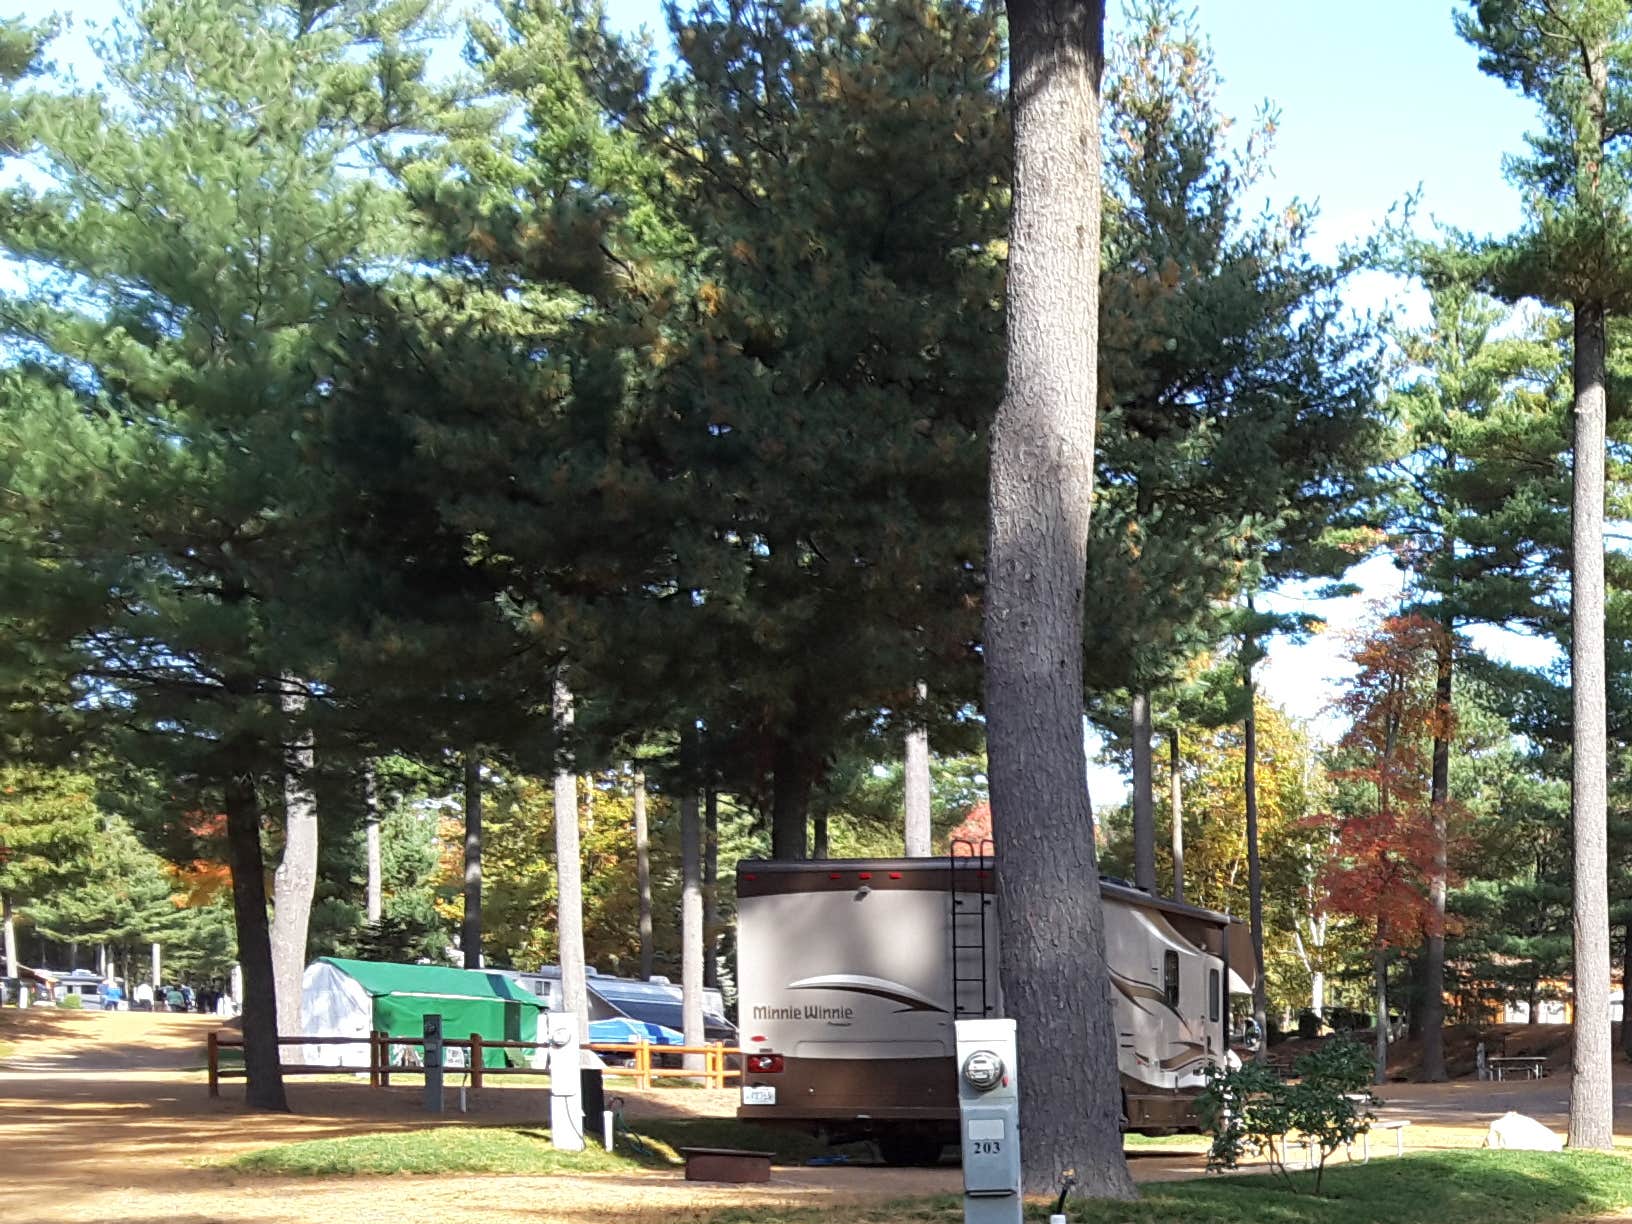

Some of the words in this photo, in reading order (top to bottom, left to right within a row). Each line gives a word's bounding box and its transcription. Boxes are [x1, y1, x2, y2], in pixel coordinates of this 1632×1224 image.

[753, 1005, 801, 1020] Minnie
[804, 1005, 853, 1020] Winnie
[974, 1142, 1001, 1154] 203
